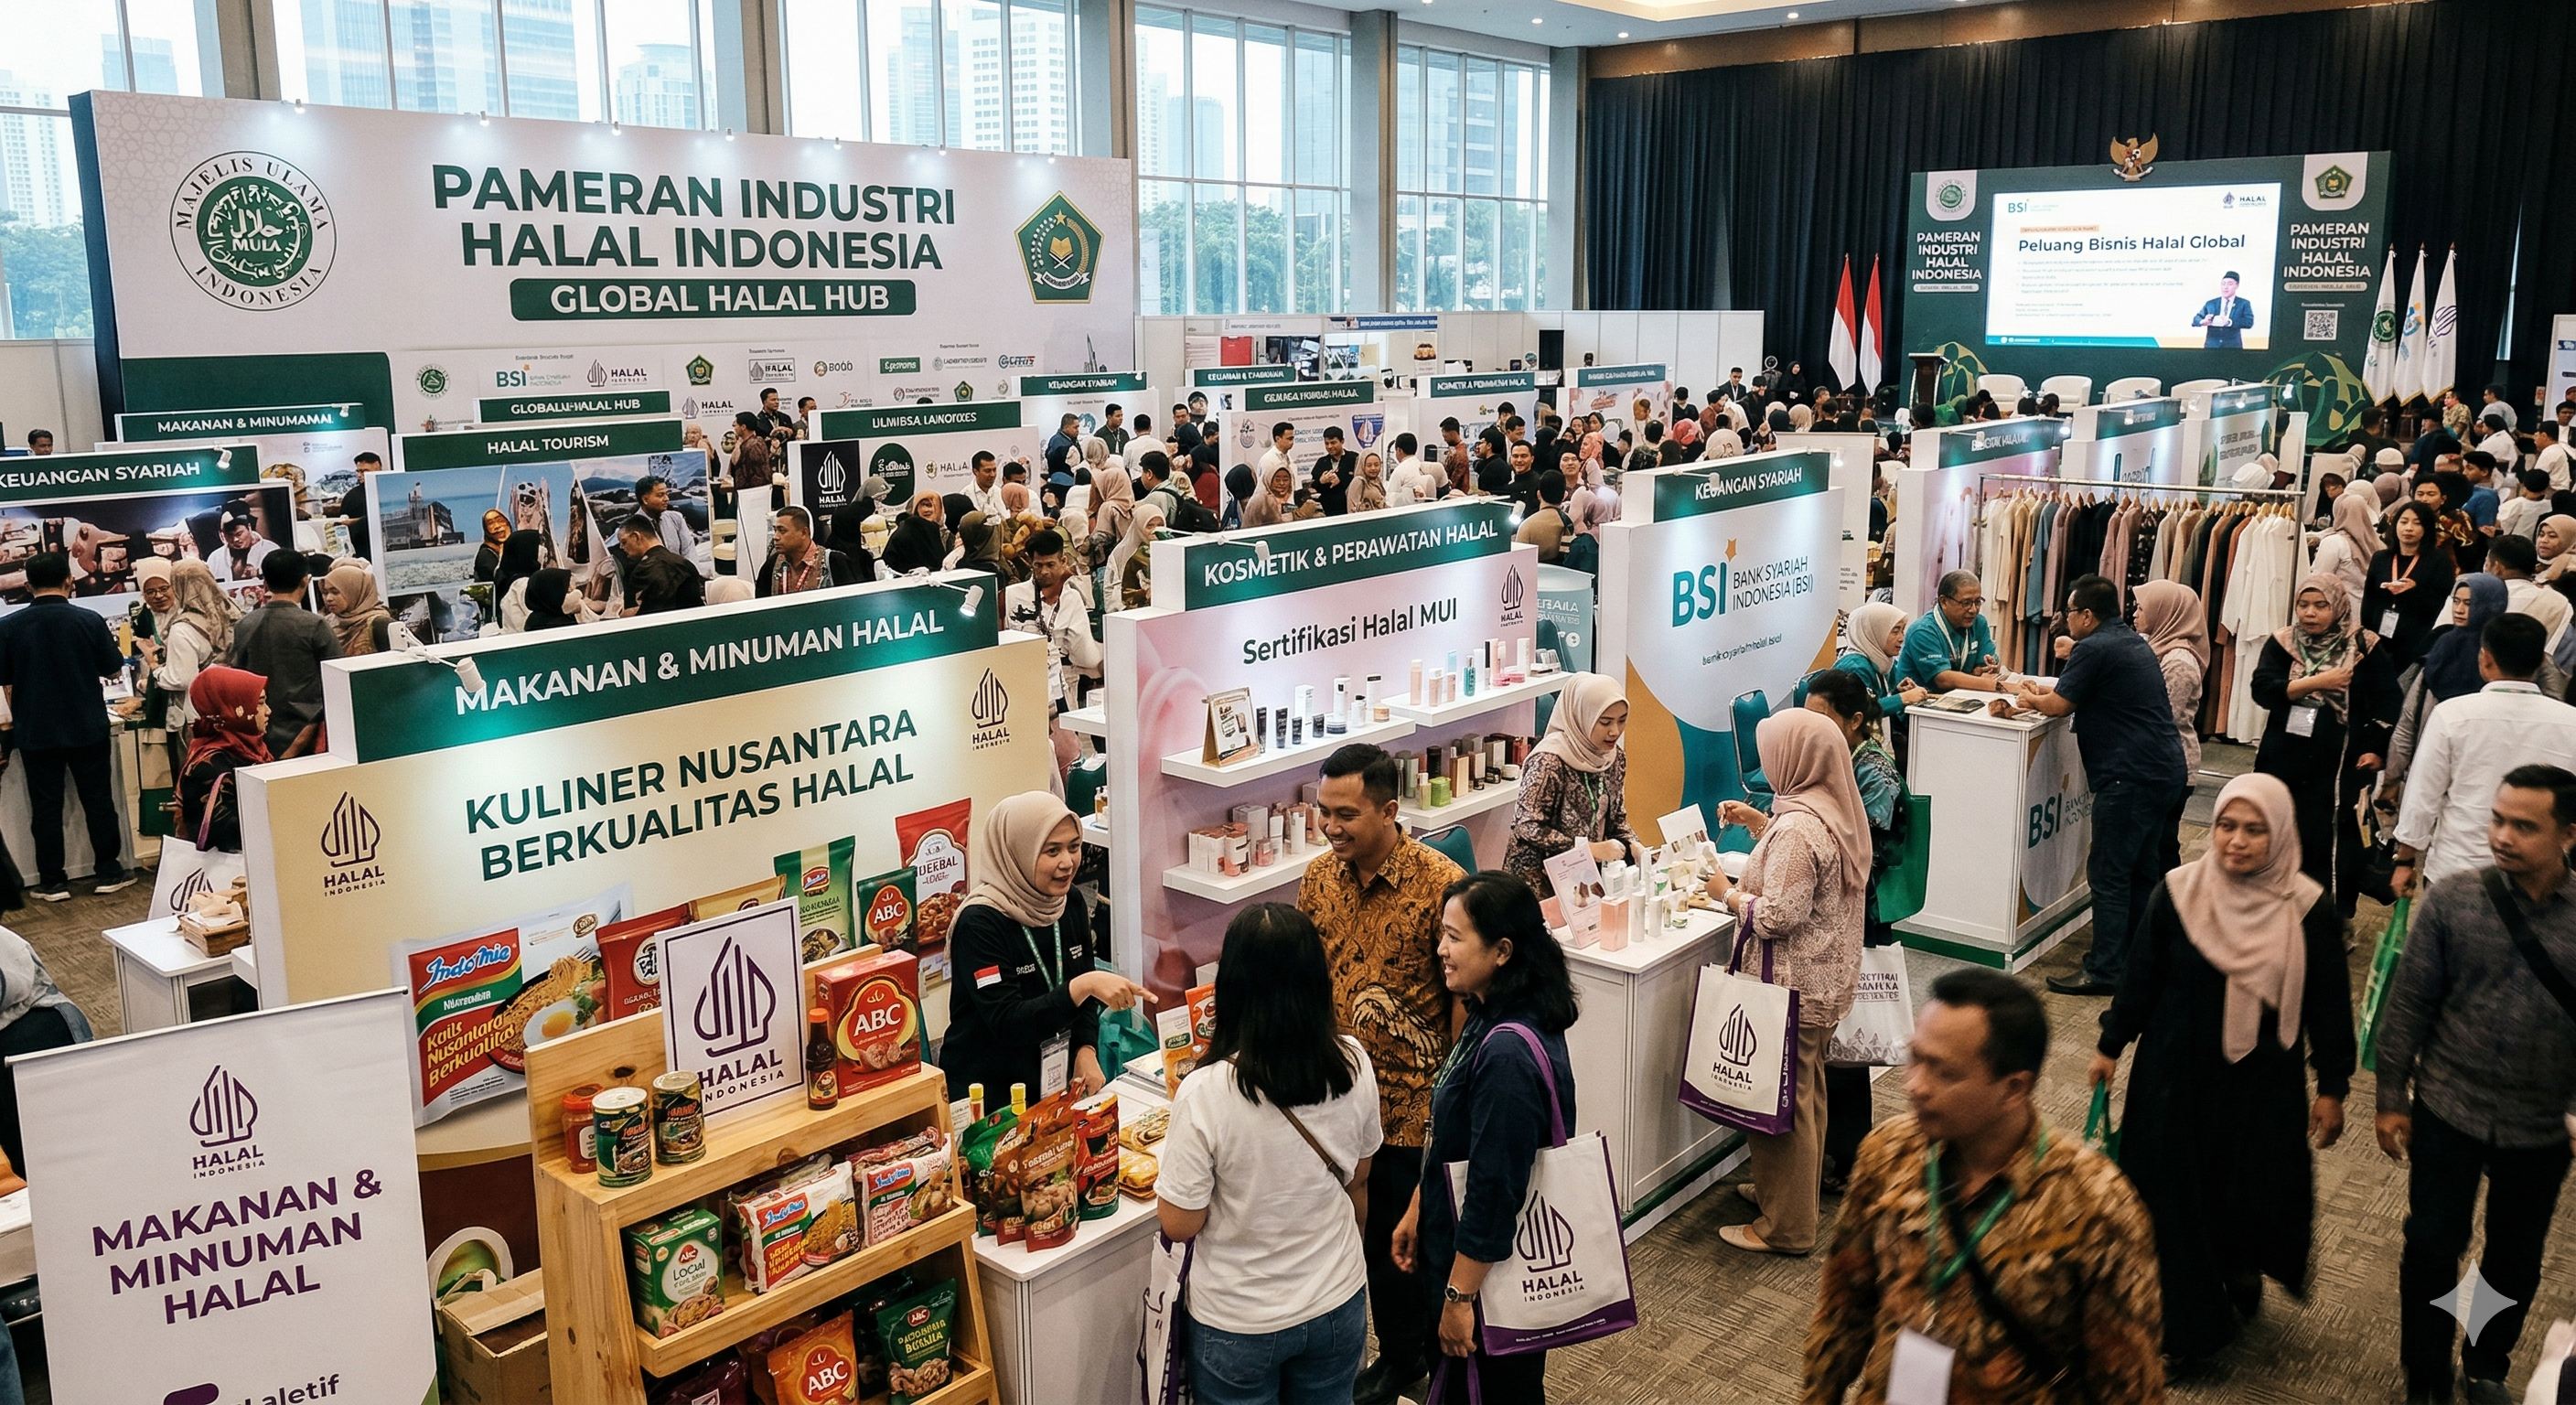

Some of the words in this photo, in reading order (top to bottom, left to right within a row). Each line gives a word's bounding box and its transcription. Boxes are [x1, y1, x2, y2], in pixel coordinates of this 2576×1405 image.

[176, 156, 255, 231] MAJELIS
[264, 160, 329, 232] ULAMA
[431, 163, 722, 218] PAMERAN
[740, 177, 956, 225] INDUSTRI
[2008, 201, 2028, 213] BSI
[1916, 231, 1981, 243] PAMERAN
[2290, 222, 2370, 236] PAMERAN
[461, 223, 659, 267] HALAL
[674, 227, 944, 271] INDONESIA
[1918, 243, 1979, 256] INDUSTRI
[2018, 239, 2084, 254] Peluang
[2088, 236, 2138, 252] Bisnis
[2141, 235, 2184, 250] Halal
[2189, 234, 2246, 249] Global
[2291, 237, 2366, 250] INDUSTRI
[1926, 256, 1970, 268] HALAL
[2301, 252, 2355, 263] HALAL
[1911, 268, 1982, 280] INDONESIA
[2283, 265, 2372, 278] INDONESIA
[194, 264, 323, 306] INDONESIA
[551, 284, 702, 313] GLOBAL
[709, 285, 818, 312] HALAL
[825, 284, 889, 311] HUB
[496, 370, 526, 388] BSI
[611, 368, 648, 378] HALAL
[614, 399, 641, 411] HUB
[156, 417, 234, 434] MAKANAN
[237, 418, 246, 429] &
[487, 437, 540, 456] HALAL
[541, 434, 609, 452] TOURISM
[114, 462, 201, 481] SYARIAH
[1758, 467, 1803, 489] SYARIAH
[1205, 549, 1310, 587] KOSMETIK
[1314, 545, 1327, 568] &
[1332, 527, 1441, 564] PERAWATAN
[1445, 519, 1498, 544] HALAL
[1733, 570, 1764, 591] BANK
[1765, 555, 1809, 584] SYARIAH
[1672, 561, 1728, 628] BSI
[1733, 580, 1791, 612] INDONESIA
[1500, 610, 1523, 623] HALAL
[1242, 615, 1356, 666] Sertifikasi
[1362, 604, 1414, 641] Halal
[1420, 597, 1458, 627] MUI
[455, 655, 648, 716] MAKANAN
[656, 650, 680, 681] &
[688, 622, 844, 678] MINUMAN
[851, 608, 946, 649] HALAL
[972, 727, 1010, 745] HALAL
[465, 761, 668, 834] KULINER
[677, 709, 918, 789] NUSANTARA
[480, 781, 782, 884] BERKUALITAS
[791, 752, 916, 810] HALAL
[2028, 792, 2063, 850] BSI
[323, 865, 385, 889] HALAL
[324, 879, 386, 897] INDONESIA
[874, 901, 905, 925] ABC
[853, 1003, 901, 1037] ABC
[699, 1049, 784, 1090] HALAL
[1712, 1061, 1753, 1084] HALAL
[704, 1069, 786, 1103] NDONESIA
[191, 1144, 264, 1171] HALAL
[193, 1159, 266, 1180] INDONESIA
[91, 1175, 339, 1258] MAKANAN
[352, 1168, 383, 1200] &
[163, 1263, 322, 1325] HALAL
[1522, 1271, 1583, 1294] HALAL
[808, 1360, 848, 1396] ABC
